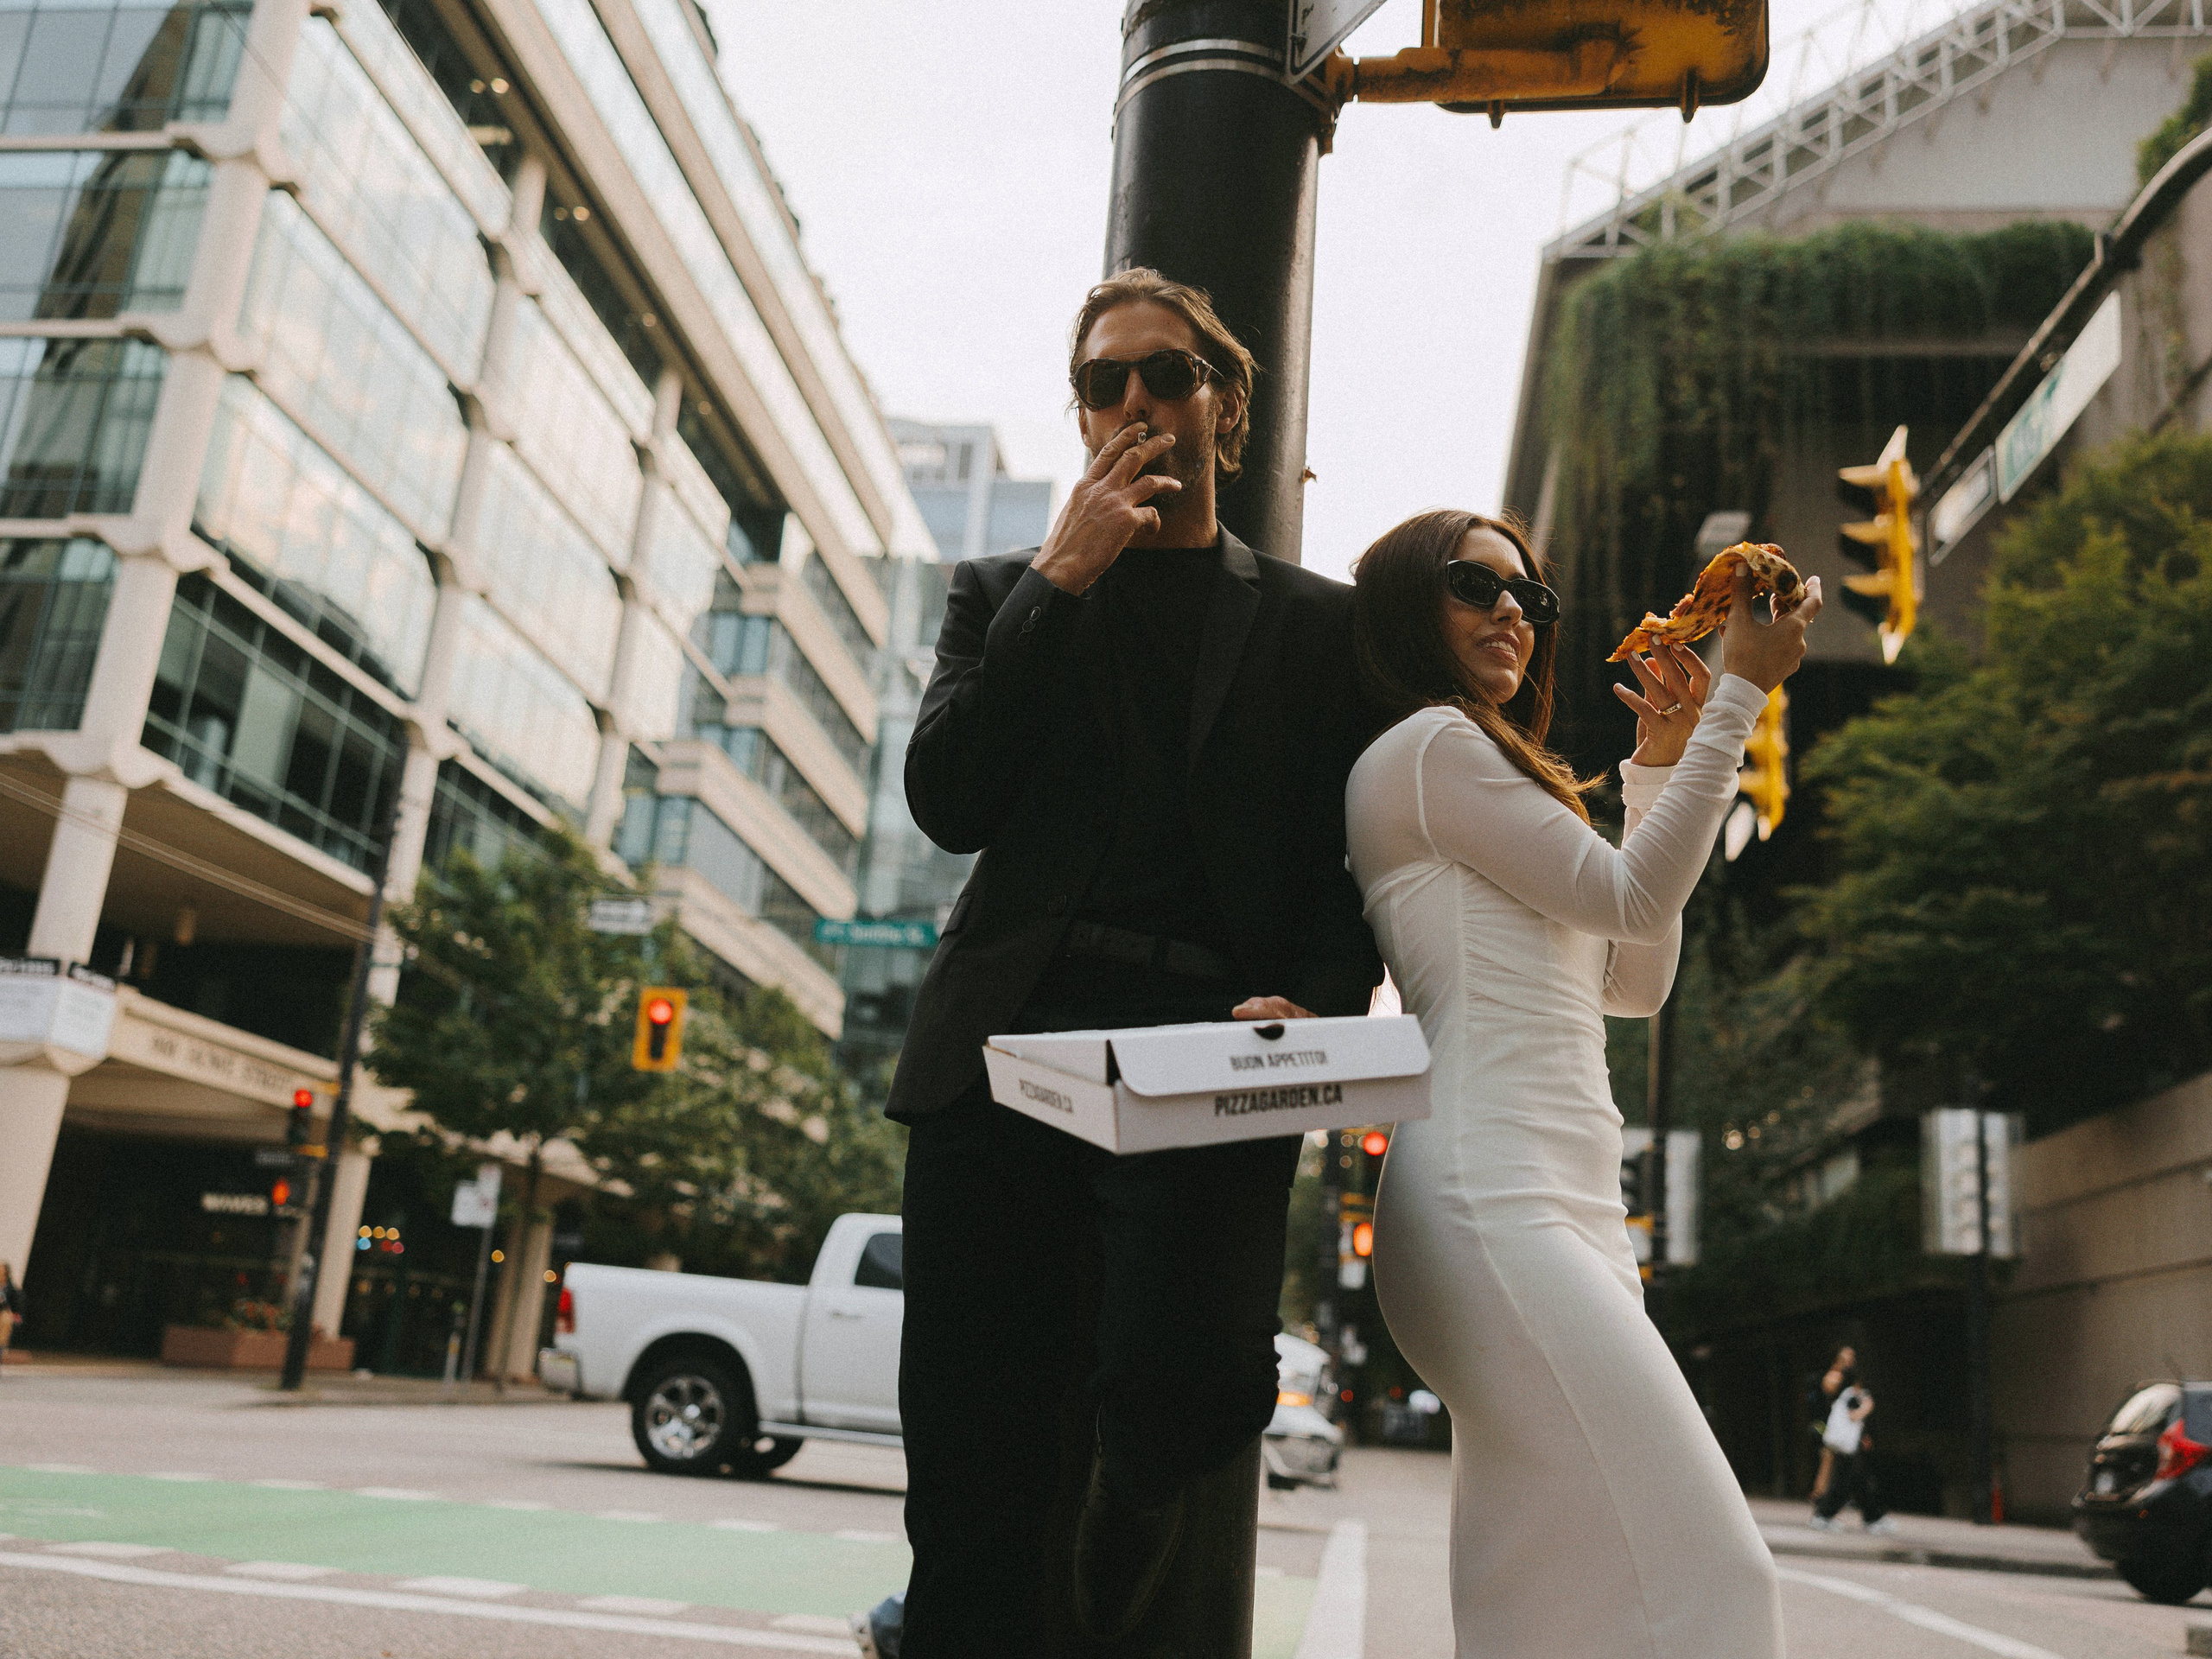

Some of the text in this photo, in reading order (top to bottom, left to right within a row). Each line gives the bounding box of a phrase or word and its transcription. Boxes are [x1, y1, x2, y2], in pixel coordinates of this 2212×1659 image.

[1229, 1055, 1264, 1071] BUON
[1019, 1078, 1073, 1113] PIZZAGARDEN.CA
[1214, 1084, 1343, 1116] PIZZAGARDEN.CA
